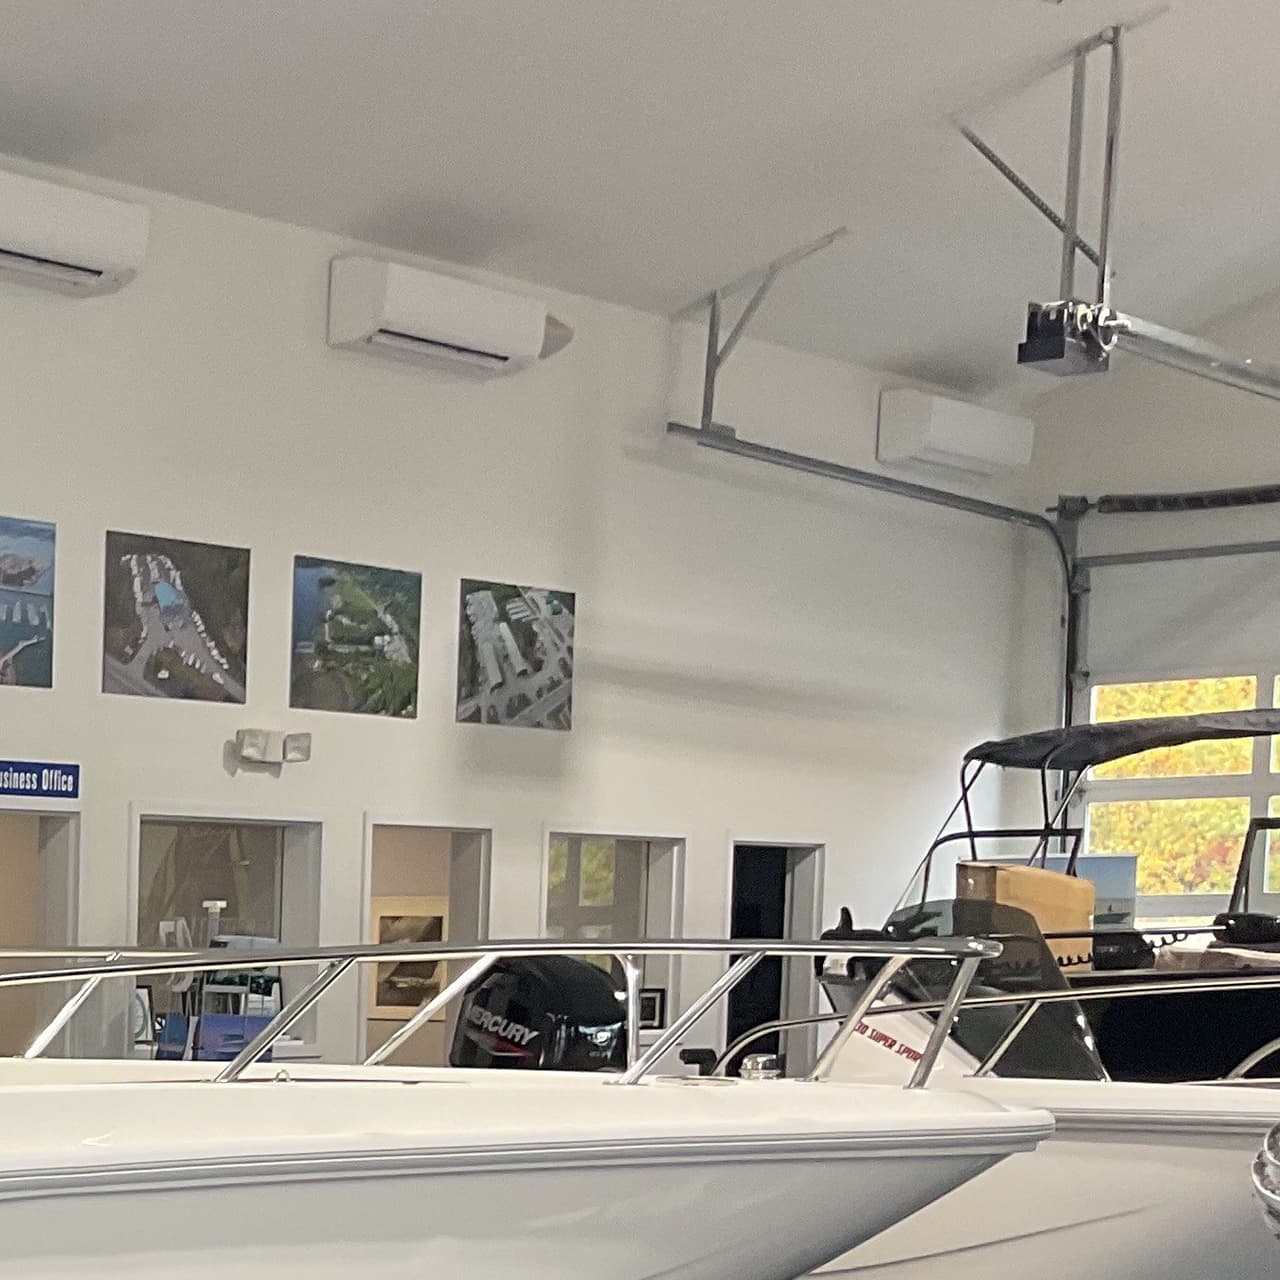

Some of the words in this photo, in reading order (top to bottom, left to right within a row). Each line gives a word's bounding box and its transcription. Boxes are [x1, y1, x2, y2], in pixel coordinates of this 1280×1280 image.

[42, 769, 73, 792] Office
[867, 1028, 897, 1049] SUPER
[895, 1043, 922, 1062] SPOR
